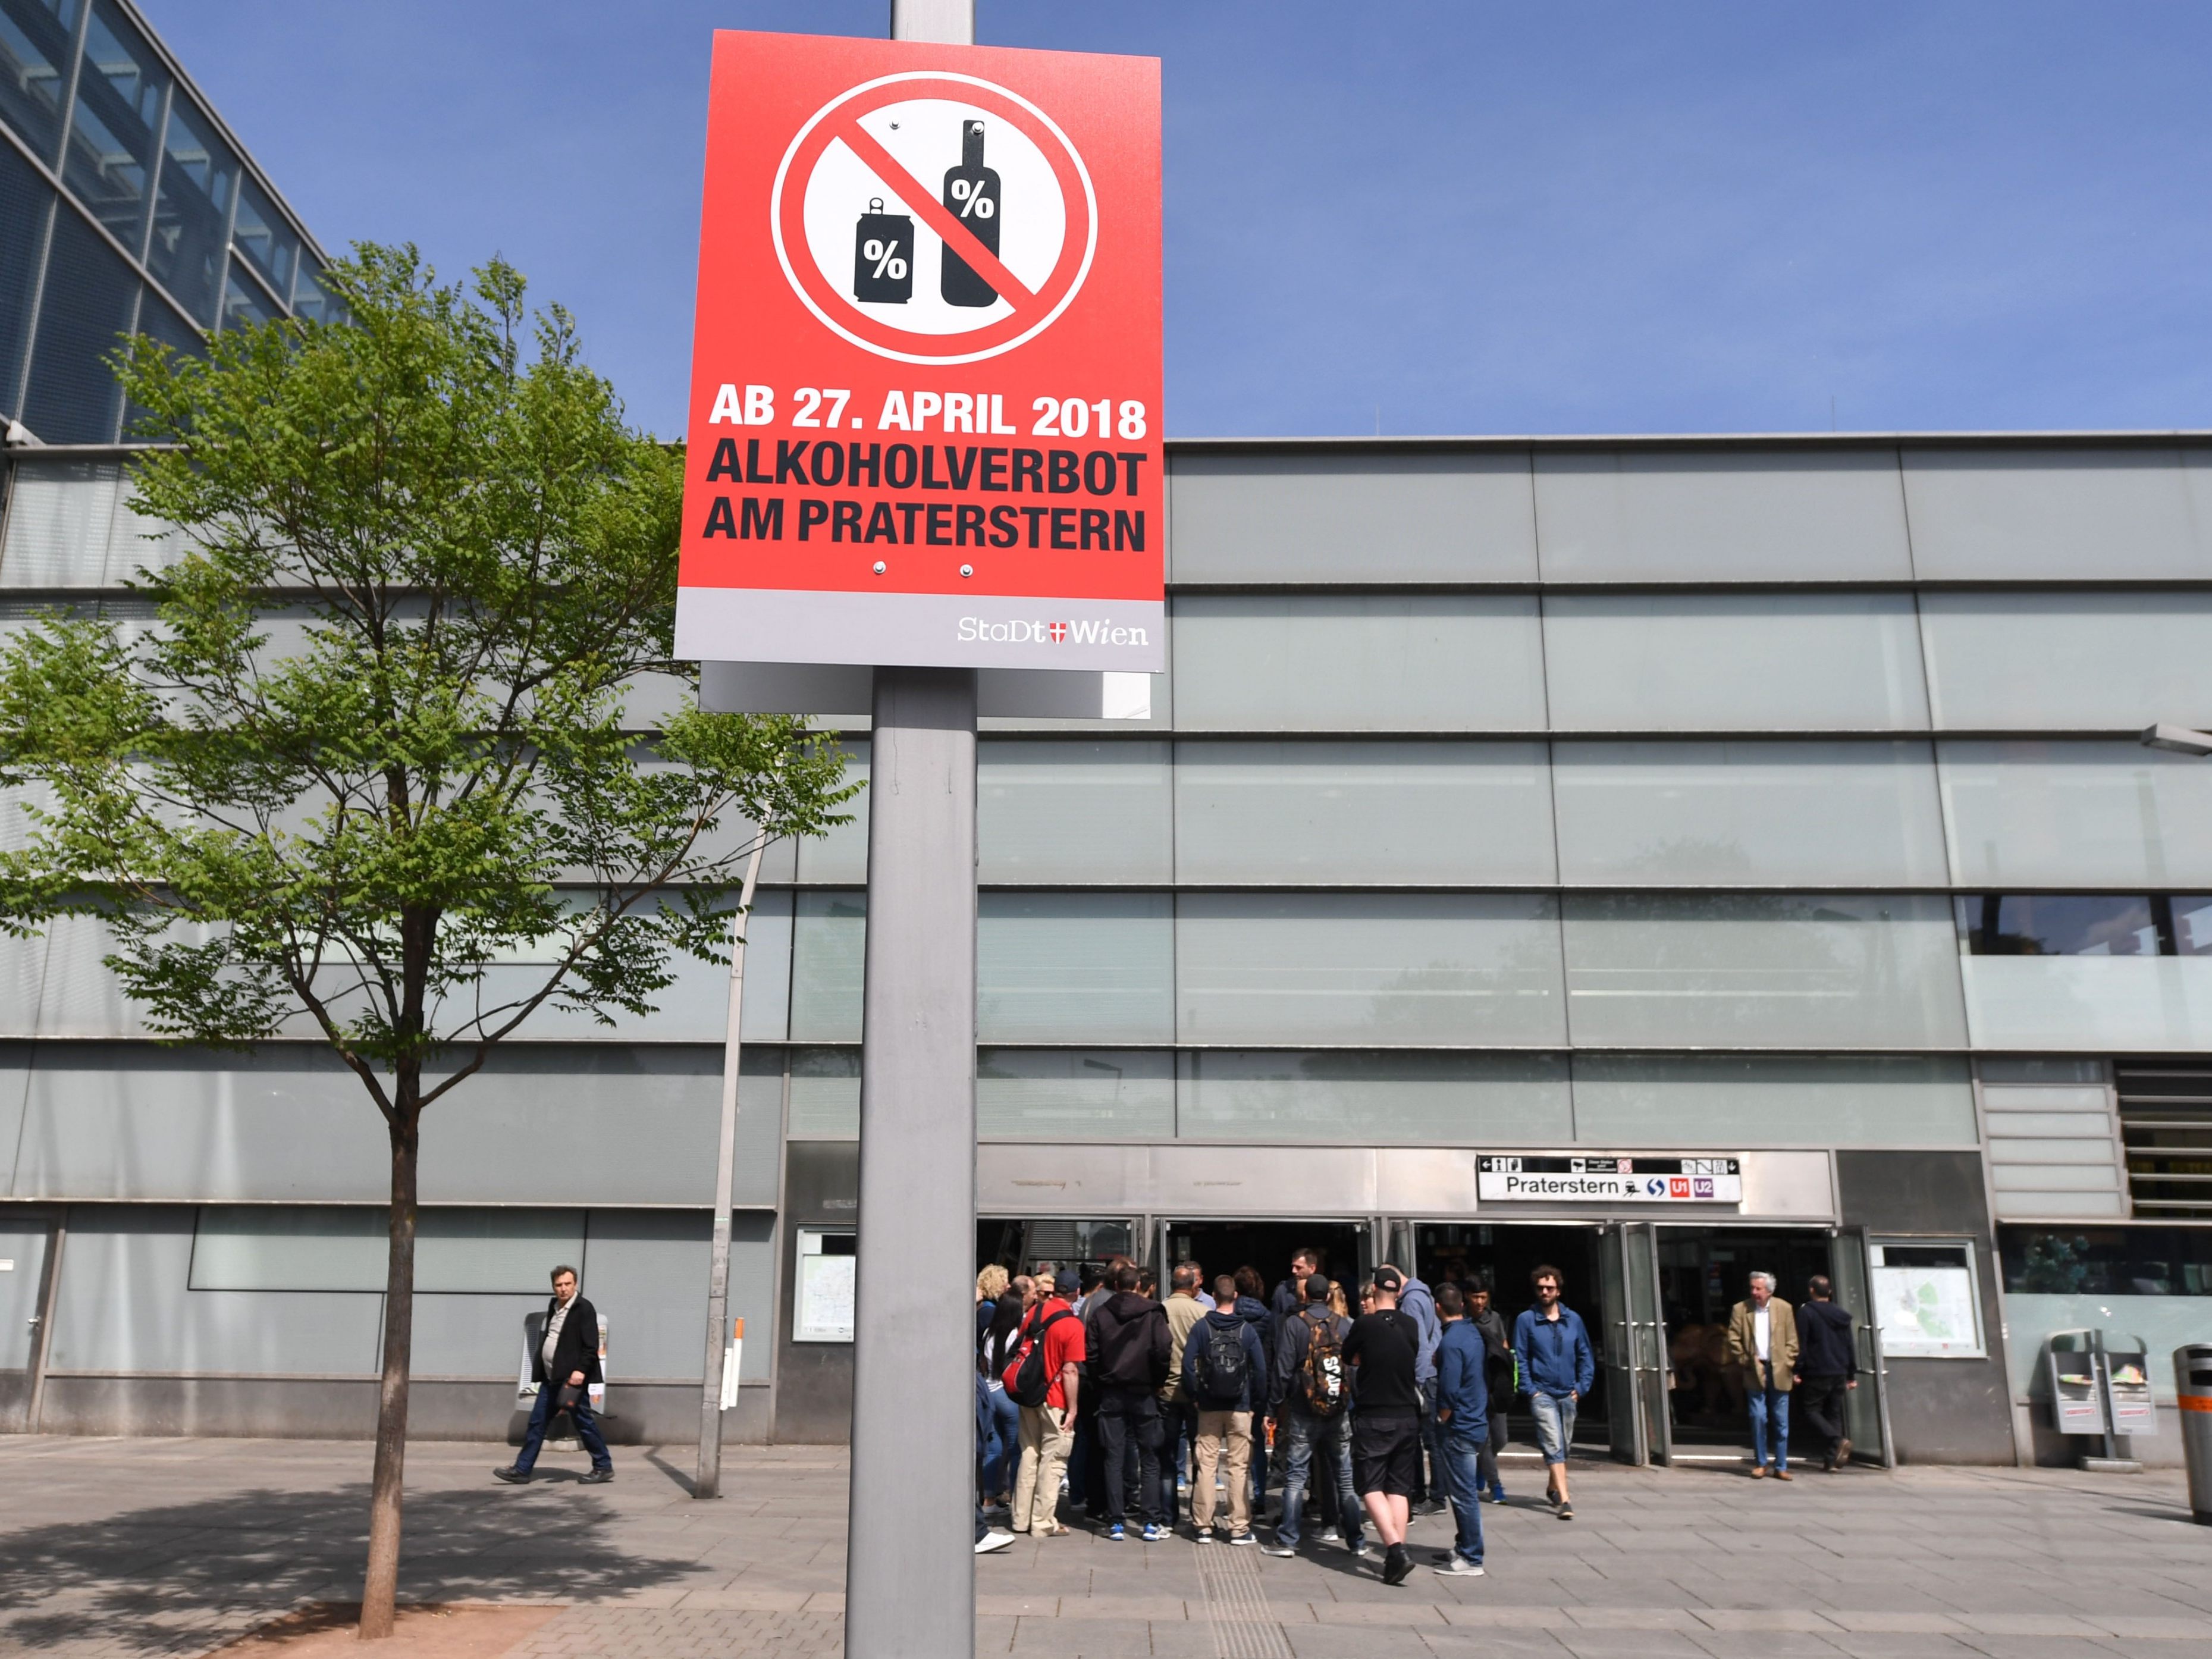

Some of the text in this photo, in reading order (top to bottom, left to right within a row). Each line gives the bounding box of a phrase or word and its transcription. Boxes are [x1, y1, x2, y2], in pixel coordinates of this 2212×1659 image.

[708, 384, 1147, 440] AB 27. APRIL 2018
[706, 438, 1147, 496] ALKOHOLVERBOT
[703, 496, 1145, 552] AM PRATERSTERN
[1069, 618, 1149, 646] Wien
[1507, 1177, 1712, 1194] Praterstern U1 U2
